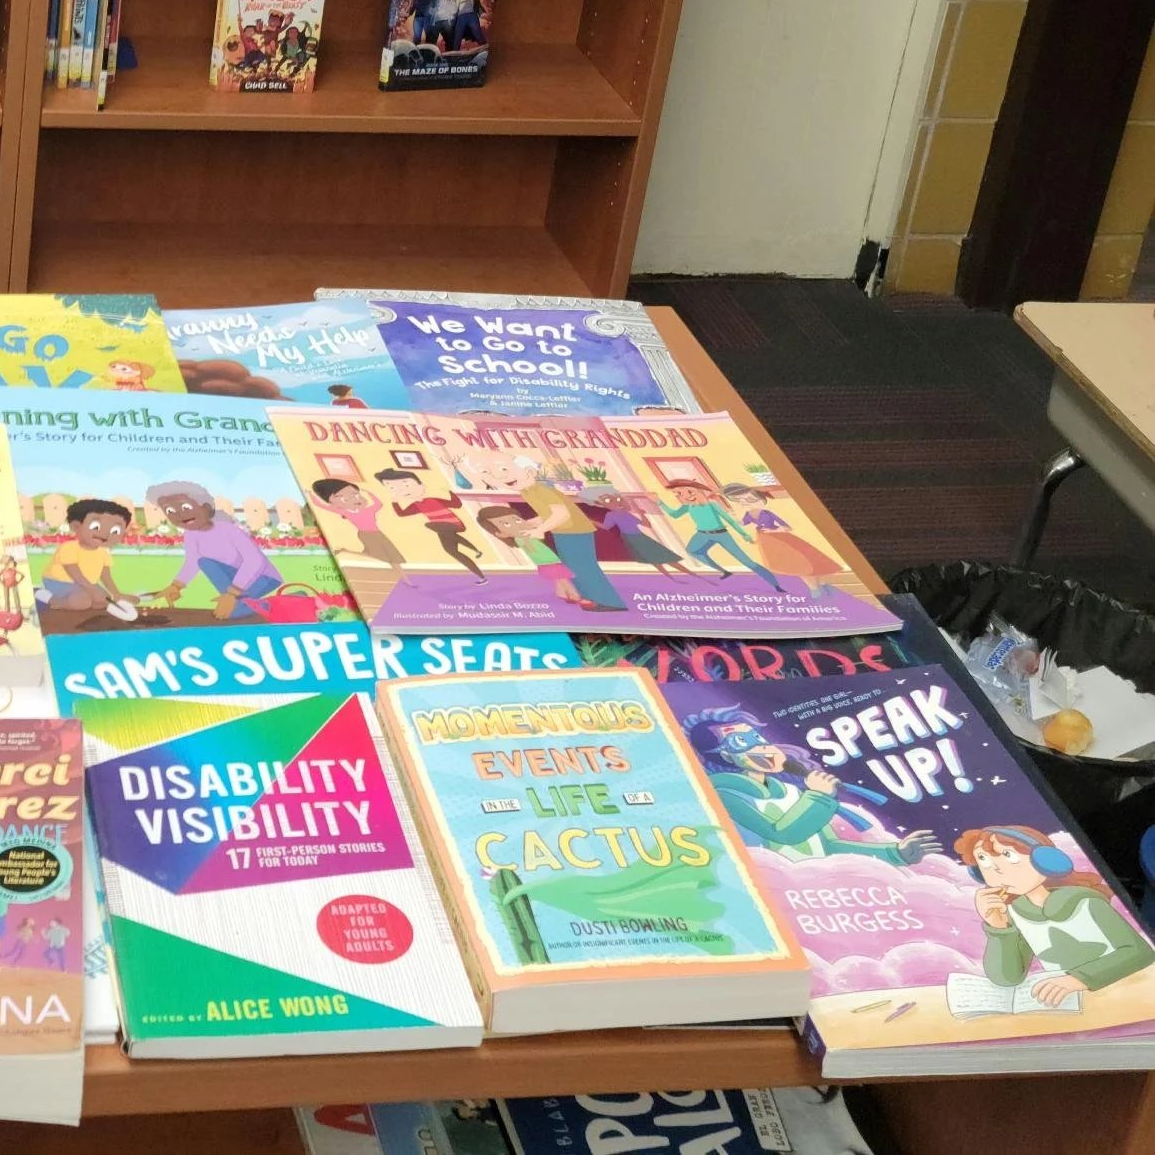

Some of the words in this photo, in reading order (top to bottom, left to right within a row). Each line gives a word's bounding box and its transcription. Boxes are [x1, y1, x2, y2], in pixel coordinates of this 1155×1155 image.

[412, 68, 436, 76] MAZE
[451, 65, 478, 74] BONES
[268, 81, 287, 90] SELL
[207, 325, 296, 355] Needs
[407, 315, 466, 334] We
[475, 315, 577, 342] Want
[257, 345, 305, 367] My
[308, 327, 370, 355] Help
[436, 336, 471, 352] to
[483, 336, 525, 352] Go
[537, 340, 572, 356] to
[437, 354, 588, 380] School!
[414, 380, 443, 391] The
[444, 376, 479, 388] Fight
[483, 375, 505, 386] for
[509, 376, 580, 391] Disability
[585, 383, 631, 400] Rights
[89, 406, 164, 429] with
[303, 420, 447, 447] DANCING
[452, 426, 540, 451] WITH
[541, 426, 709, 449] GRANDDAD
[633, 593, 653, 603] An
[655, 593, 741, 605] Alzheimer's
[743, 594, 783, 607] Story
[785, 594, 807, 604] for
[637, 603, 703, 614] Children
[705, 604, 732, 614] and
[734, 604, 775, 615] Their
[777, 604, 841, 615] Families
[65, 644, 220, 698] SAM'S
[222, 630, 409, 686] SUPER
[415, 702, 654, 743] MOMENTOUS
[806, 684, 964, 767] SPEAK
[471, 745, 632, 780] EVENTS
[865, 738, 974, 803] UP!
[118, 758, 366, 801] DISABILITY
[485, 799, 497, 811] IN
[498, 798, 518, 811] THE
[526, 783, 621, 818] LIFE
[627, 793, 641, 804] OF
[642, 792, 651, 803] A
[134, 800, 372, 845] VISIBILITY
[226, 847, 251, 870] 17
[256, 845, 336, 859] FIRST-PERSON
[339, 842, 386, 854] STORIES
[475, 825, 712, 871] CACTUS
[259, 856, 281, 868] FOR
[283, 855, 319, 867] TODAY
[330, 903, 387, 917] ADAPTED
[786, 886, 908, 912] REBECCA
[343, 927, 387, 939] YOUNG
[350, 916, 375, 927] FOR
[569, 921, 617, 937] DUSTI
[619, 917, 689, 935] BOWLING
[796, 910, 924, 935] BURGESS
[345, 940, 394, 953] ADULTS
[206, 998, 273, 1022] ALICE
[278, 994, 350, 1018] WONG
